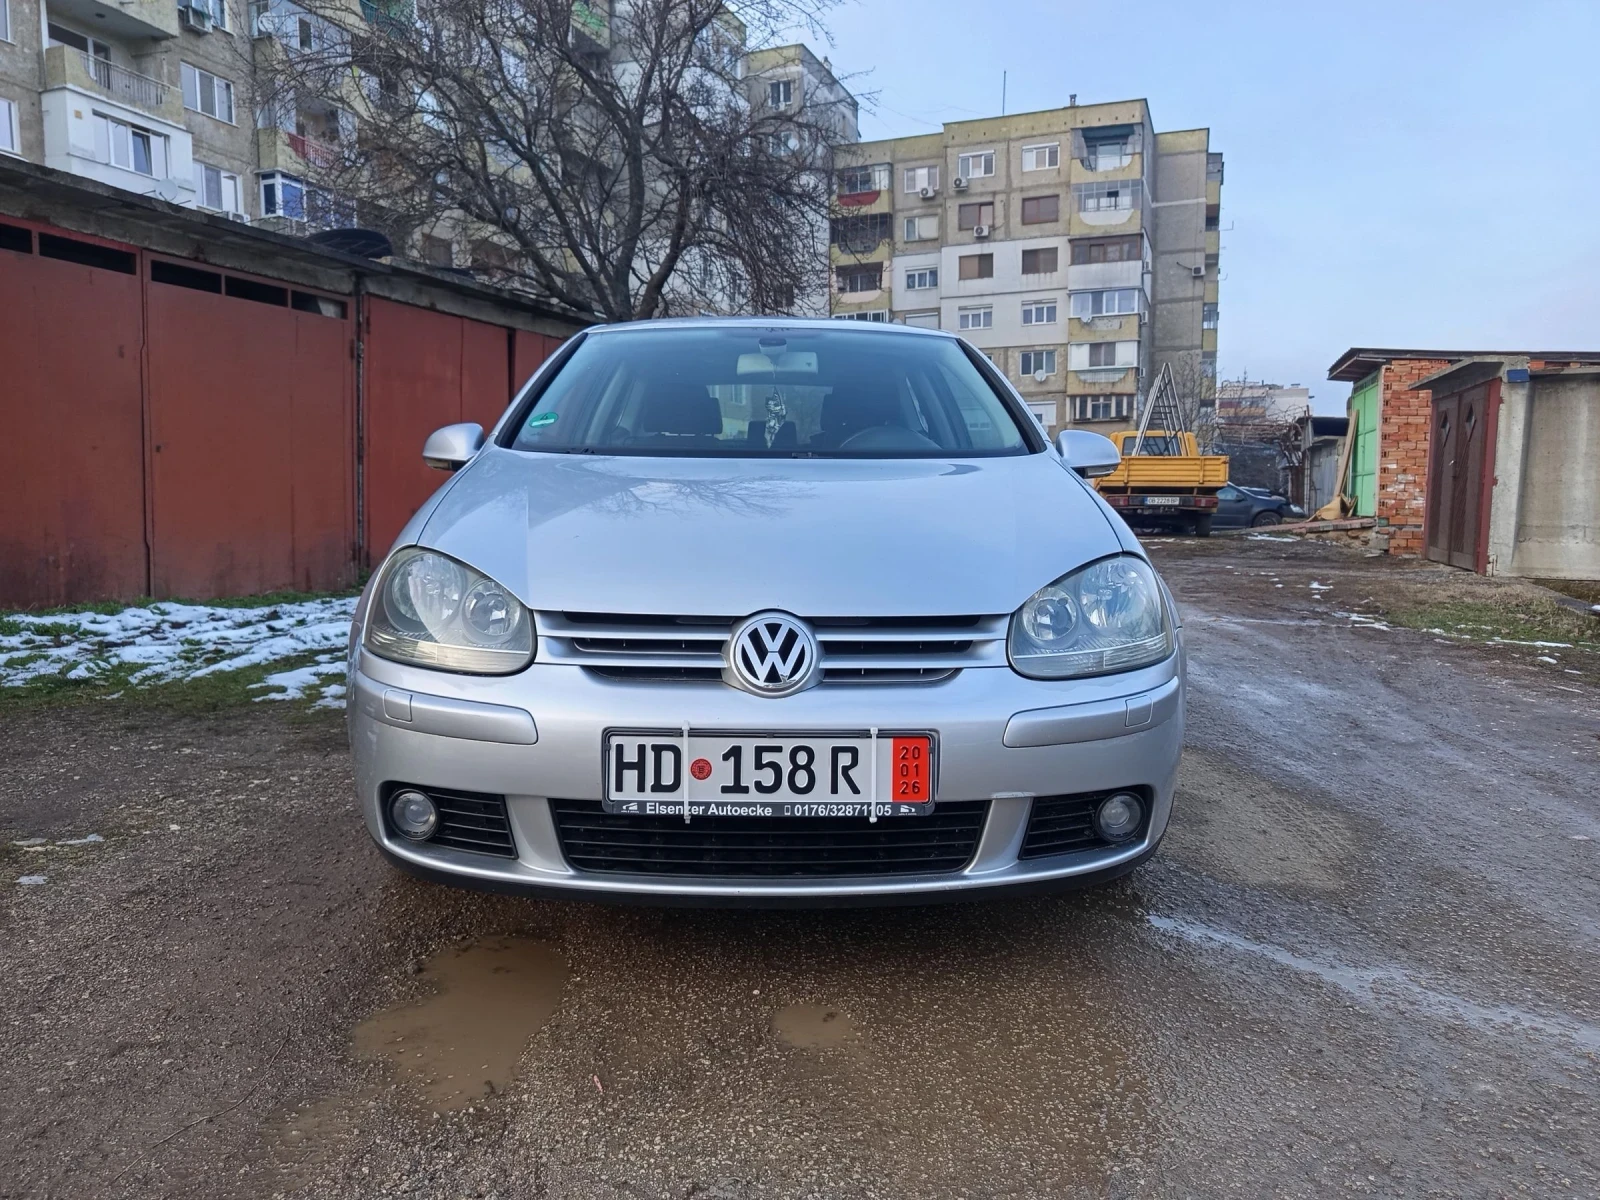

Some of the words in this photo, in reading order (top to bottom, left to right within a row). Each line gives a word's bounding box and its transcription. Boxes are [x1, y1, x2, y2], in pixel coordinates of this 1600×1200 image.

[734, 615, 812, 690] VW
[900, 746, 921, 760] 20
[614, 743, 682, 793] HD
[720, 744, 816, 795] 158
[830, 745, 861, 795] R
[900, 763, 920, 777] 01
[900, 780, 921, 795] 26
[707, 803, 773, 816] Autoecke
